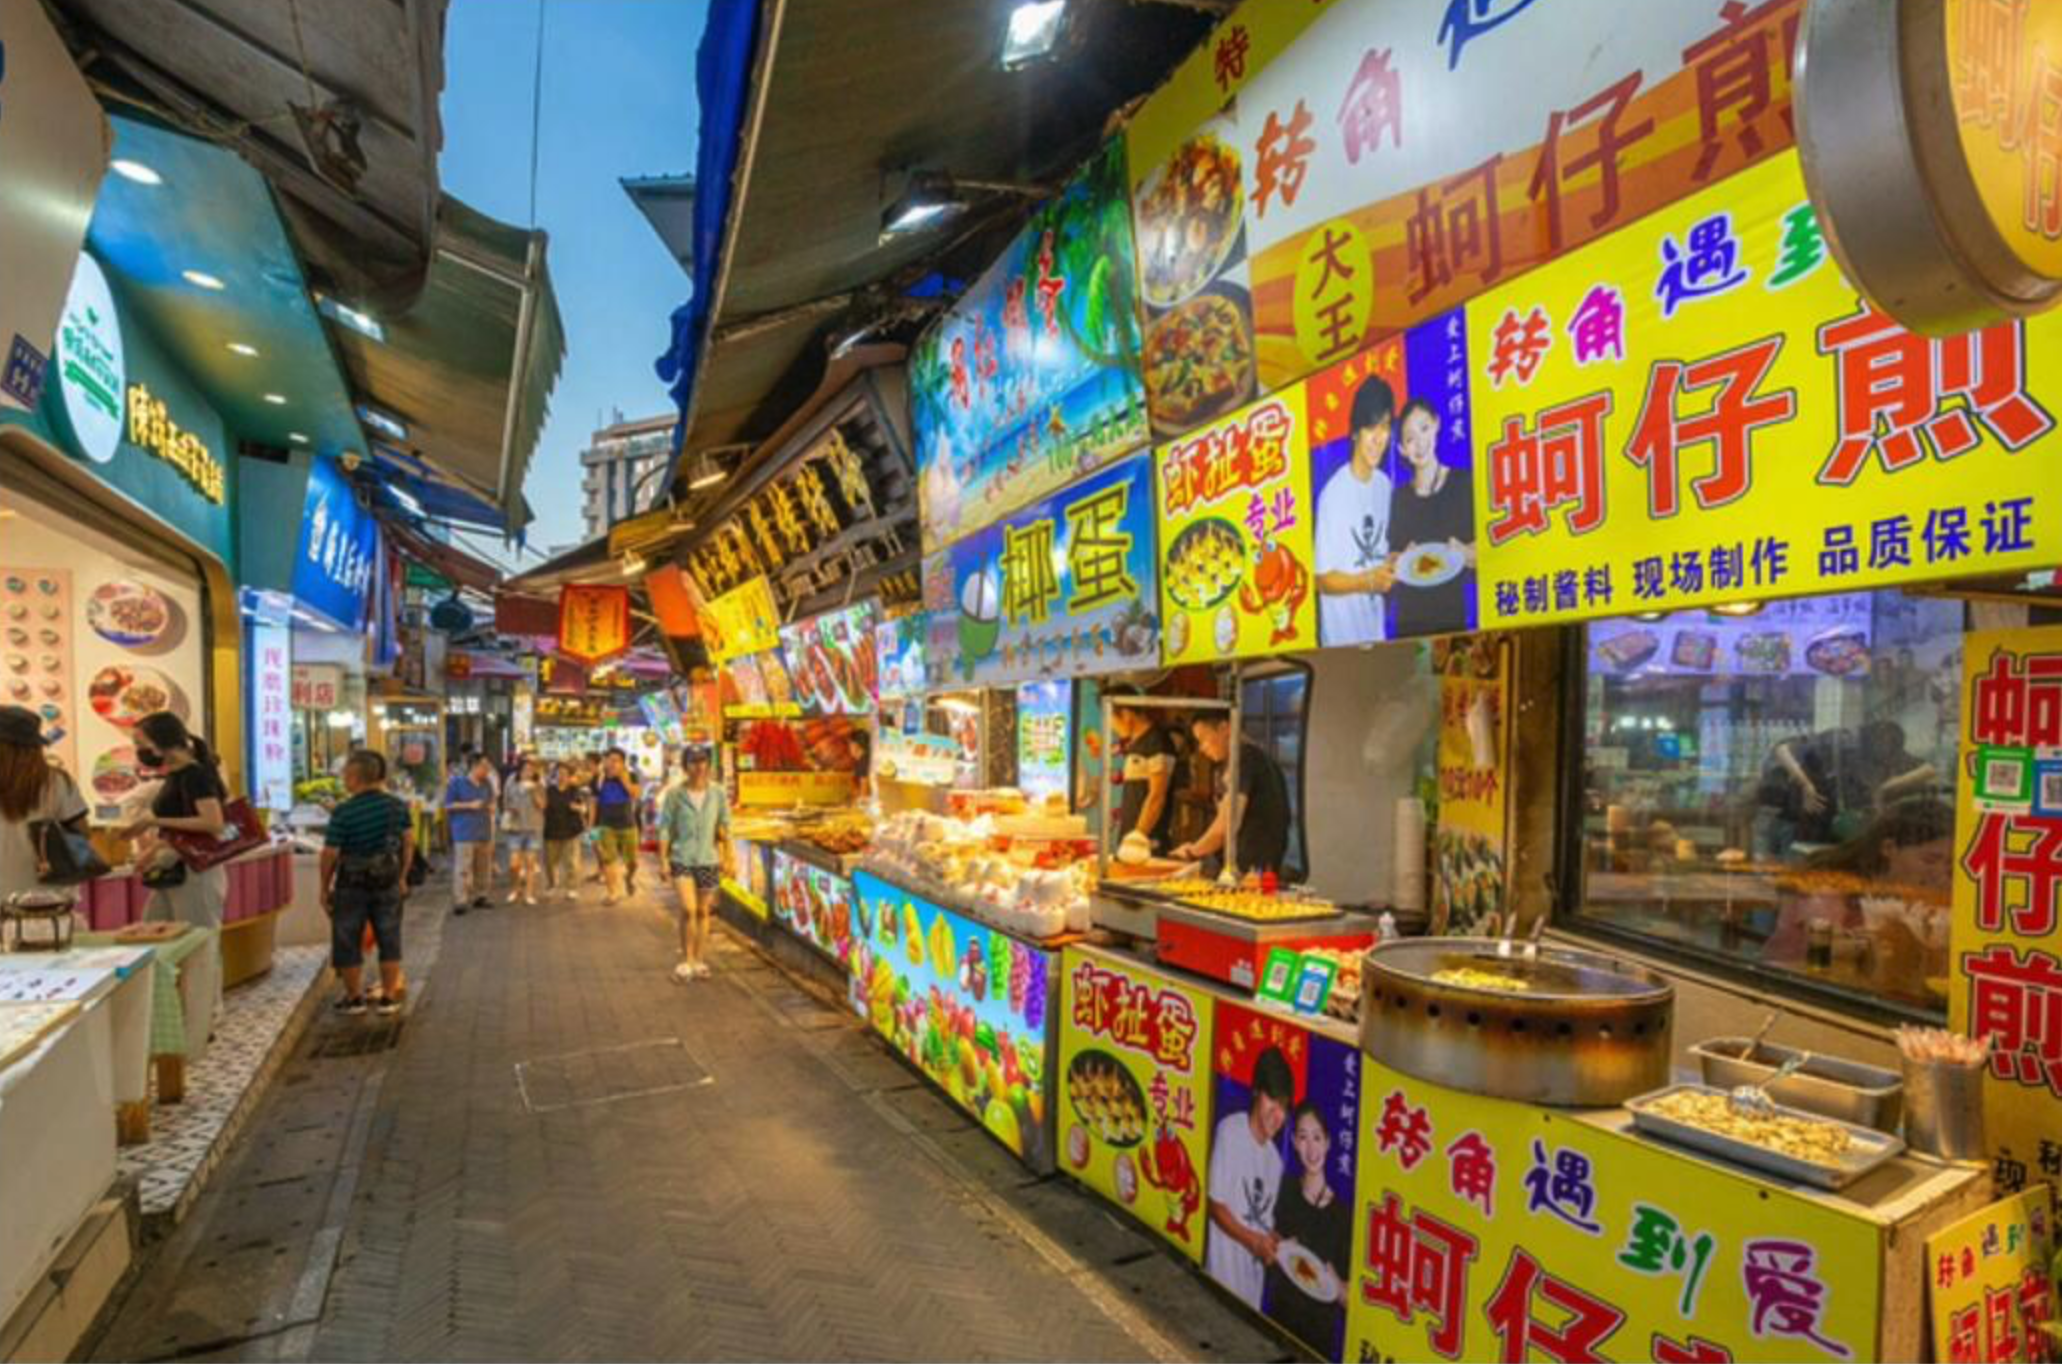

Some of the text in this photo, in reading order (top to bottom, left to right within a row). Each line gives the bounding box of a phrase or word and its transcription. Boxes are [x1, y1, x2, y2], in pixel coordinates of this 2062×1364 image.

[1213, 25, 1249, 93] 特
[1405, 0, 1798, 306] 蚵仔煎
[1309, 228, 1360, 362] 大王
[1163, 403, 1293, 519] 虾扯蛋
[1487, 299, 2056, 547] 蚵仔煎
[1001, 483, 1138, 626] 椰蛋
[1244, 487, 1297, 542] 专业
[1495, 497, 2036, 616] 秘制酱料 现场制作 品质保证
[1072, 962, 1197, 1074] 虾扯蛋
[1148, 1070, 1196, 1130] 专业
[1375, 1088, 1851, 1357] 转角遇到爱
